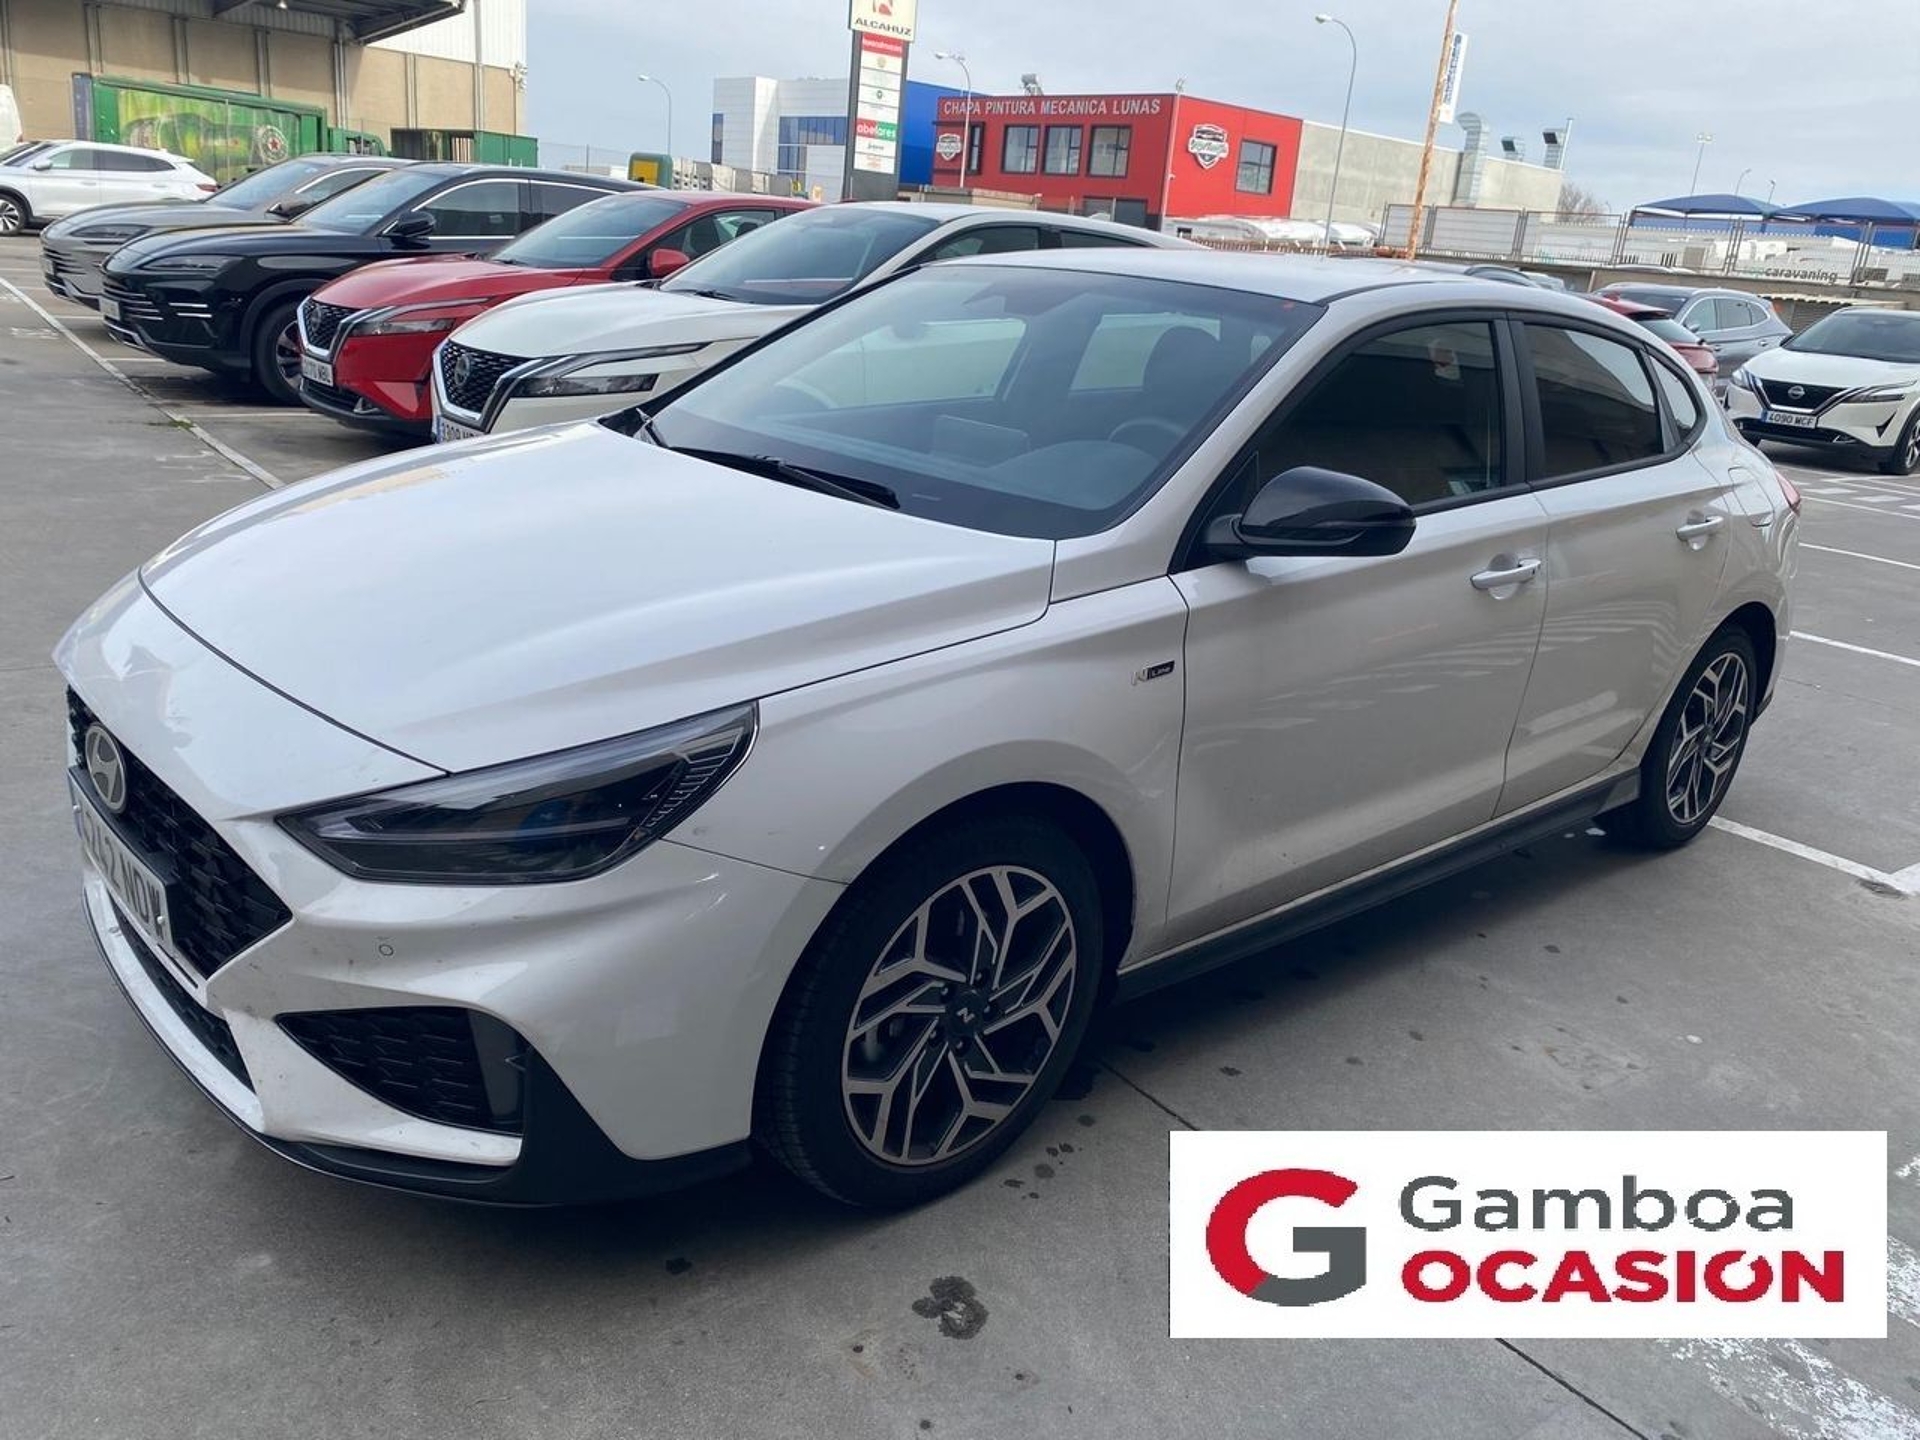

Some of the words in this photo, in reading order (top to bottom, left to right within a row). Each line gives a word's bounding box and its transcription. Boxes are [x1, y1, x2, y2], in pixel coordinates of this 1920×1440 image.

[854, 18, 912, 37] ALCAHUZ
[944, 101, 982, 116] CHAPA
[985, 100, 1036, 116] PINTURA
[1040, 99, 1107, 116] MECANICA
[1112, 98, 1161, 115] LUNAS
